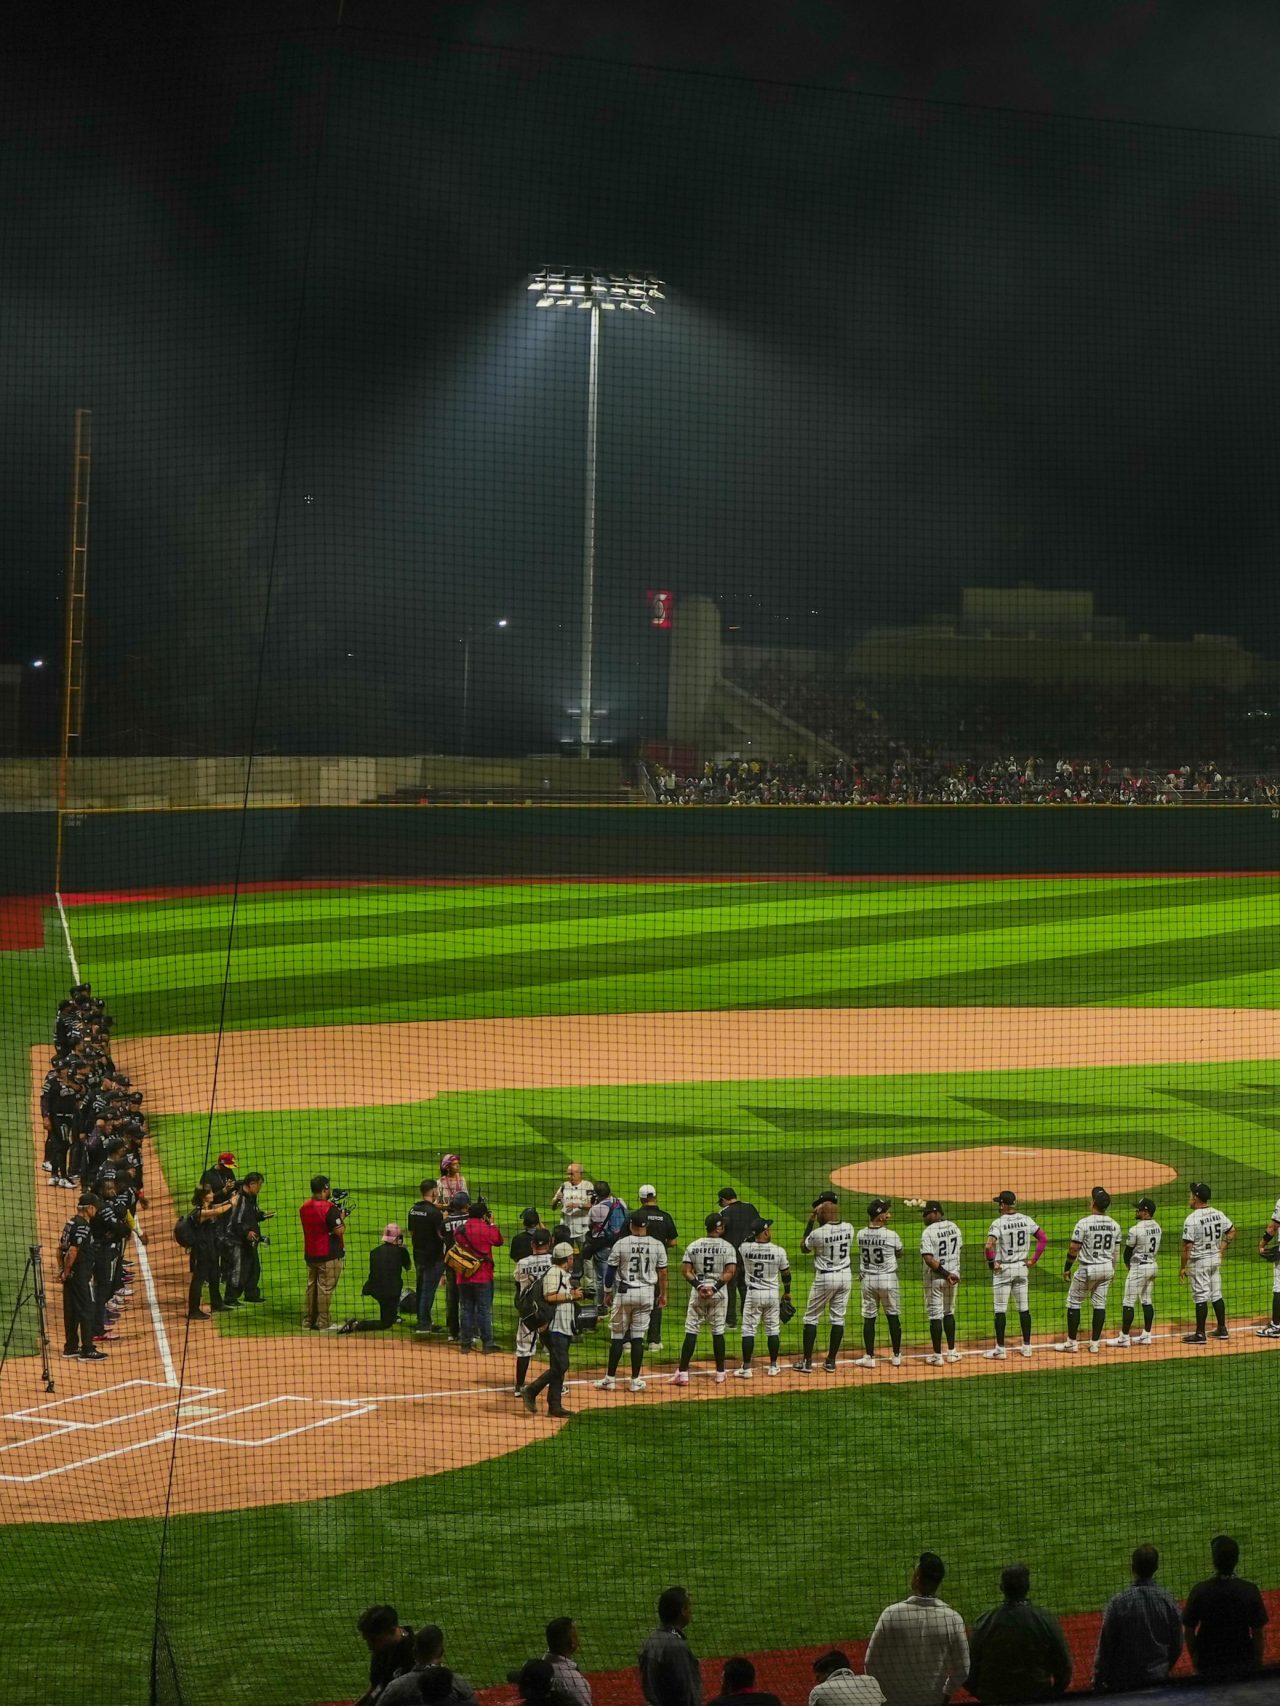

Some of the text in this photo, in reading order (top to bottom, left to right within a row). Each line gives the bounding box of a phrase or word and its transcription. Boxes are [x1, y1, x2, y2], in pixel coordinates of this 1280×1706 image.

[1009, 1230, 1026, 1248] 18
[1205, 1223, 1222, 1242] 45
[939, 1237, 958, 1256] 27
[1093, 1233, 1113, 1250] 28
[1150, 1237, 1157, 1253] 3
[830, 1243, 848, 1261] 15
[862, 1247, 885, 1264] 33
[630, 1256, 650, 1273] 31
[703, 1256, 715, 1273] 5
[754, 1262, 765, 1279] 2
